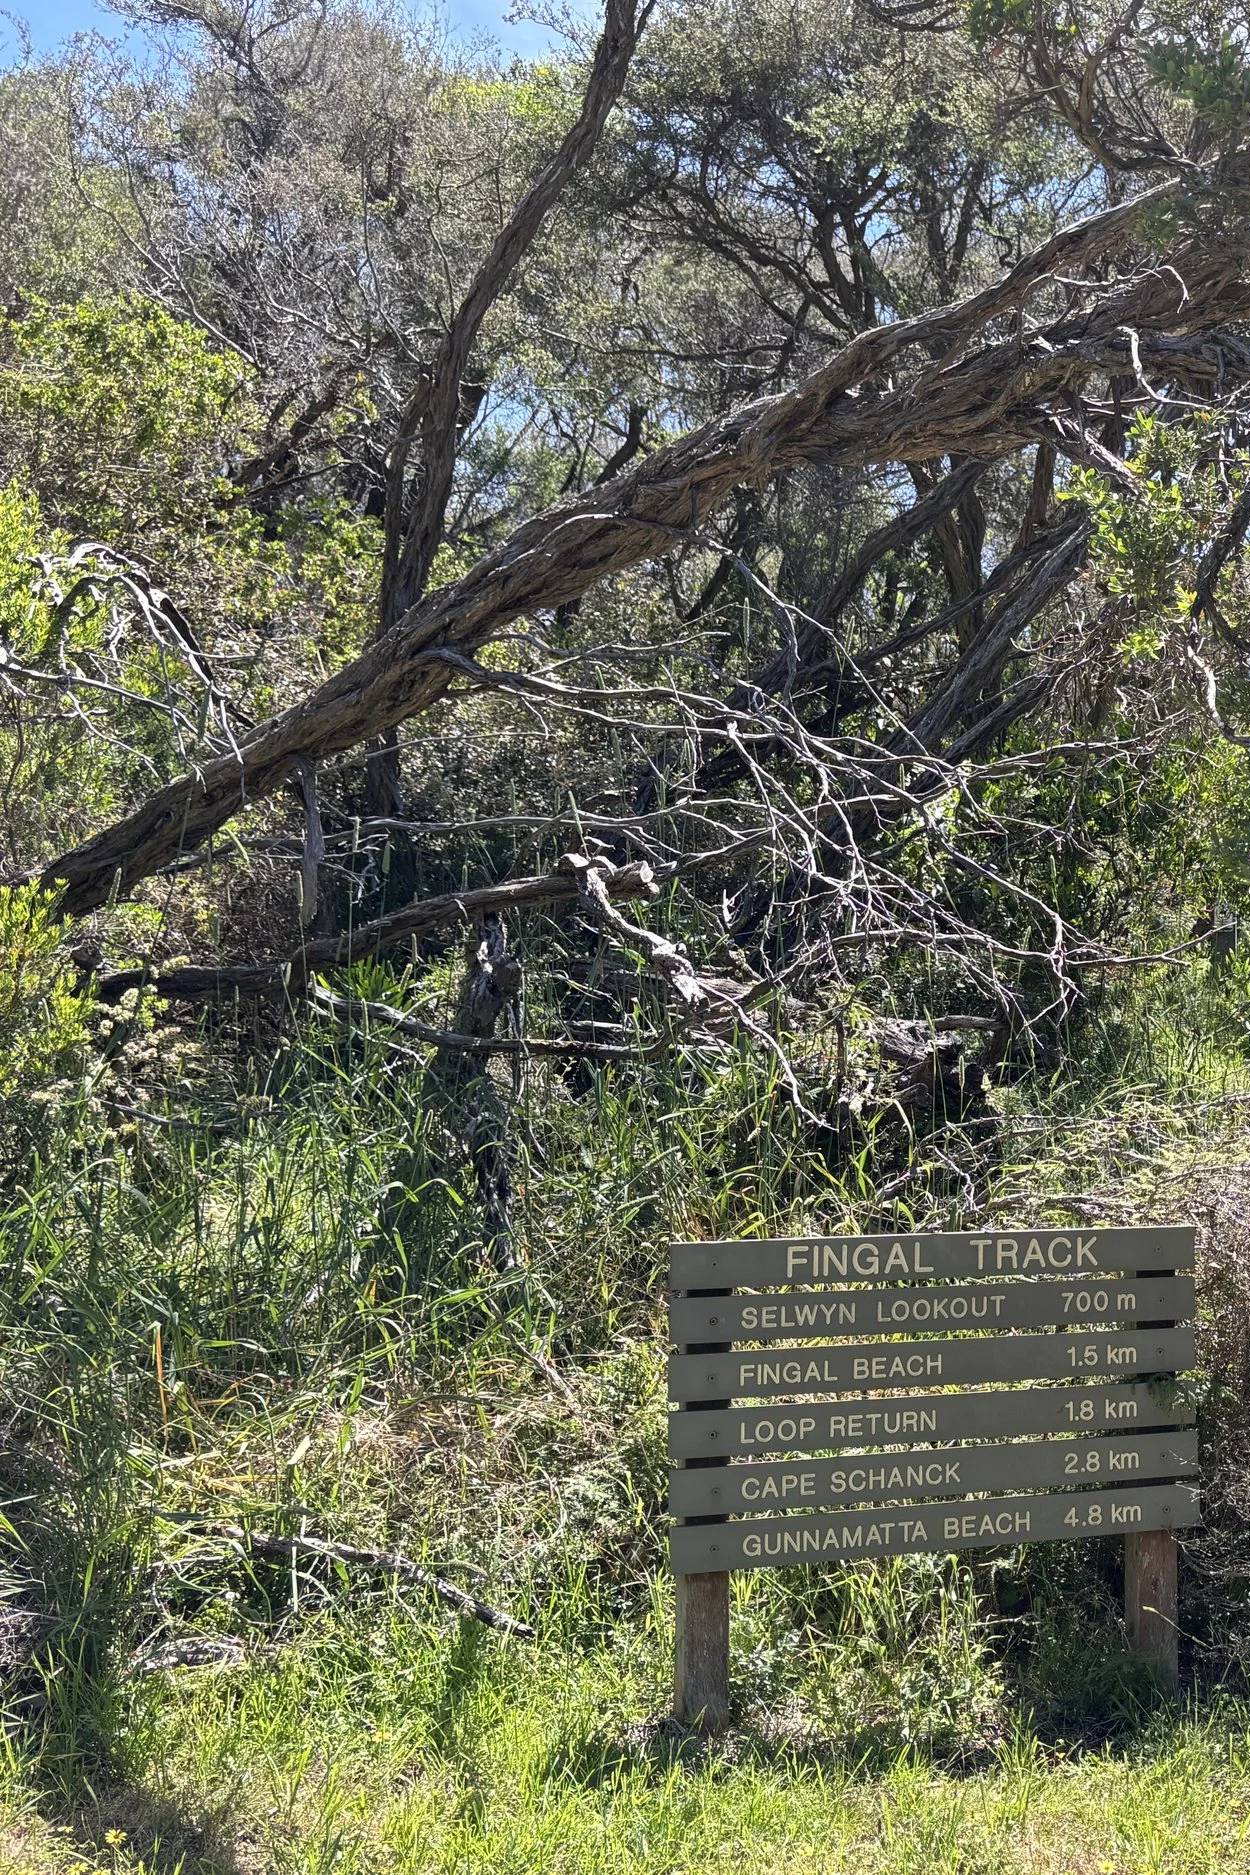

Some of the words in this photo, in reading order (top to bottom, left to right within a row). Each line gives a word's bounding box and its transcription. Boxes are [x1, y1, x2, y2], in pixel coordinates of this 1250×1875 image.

[786, 1241, 934, 1278] FINGAL
[969, 1236, 1098, 1270] TRACK
[741, 1302, 856, 1329] SELWYN
[877, 1295, 1006, 1322] LOOKOUT
[1061, 1290, 1108, 1313] 700
[1117, 1292, 1136, 1311] m
[739, 1360, 838, 1386] FINGAL
[853, 1353, 942, 1380] BEACH
[1067, 1345, 1098, 1367] 1.5
[1107, 1344, 1137, 1365] km
[740, 1418, 816, 1444] LOOP
[829, 1409, 937, 1438] RETURN
[1064, 1399, 1094, 1422] 1.8
[1105, 1398, 1138, 1419] km
[741, 1473, 816, 1500] CAPE
[830, 1462, 961, 1493] SCHANCK
[1064, 1450, 1100, 1475] 2.8
[1109, 1450, 1140, 1471] km
[742, 1520, 928, 1556] GUNNAMATTA
[943, 1510, 1031, 1540] BEACH
[1063, 1504, 1102, 1528] 4.8
[1111, 1503, 1142, 1524] km
